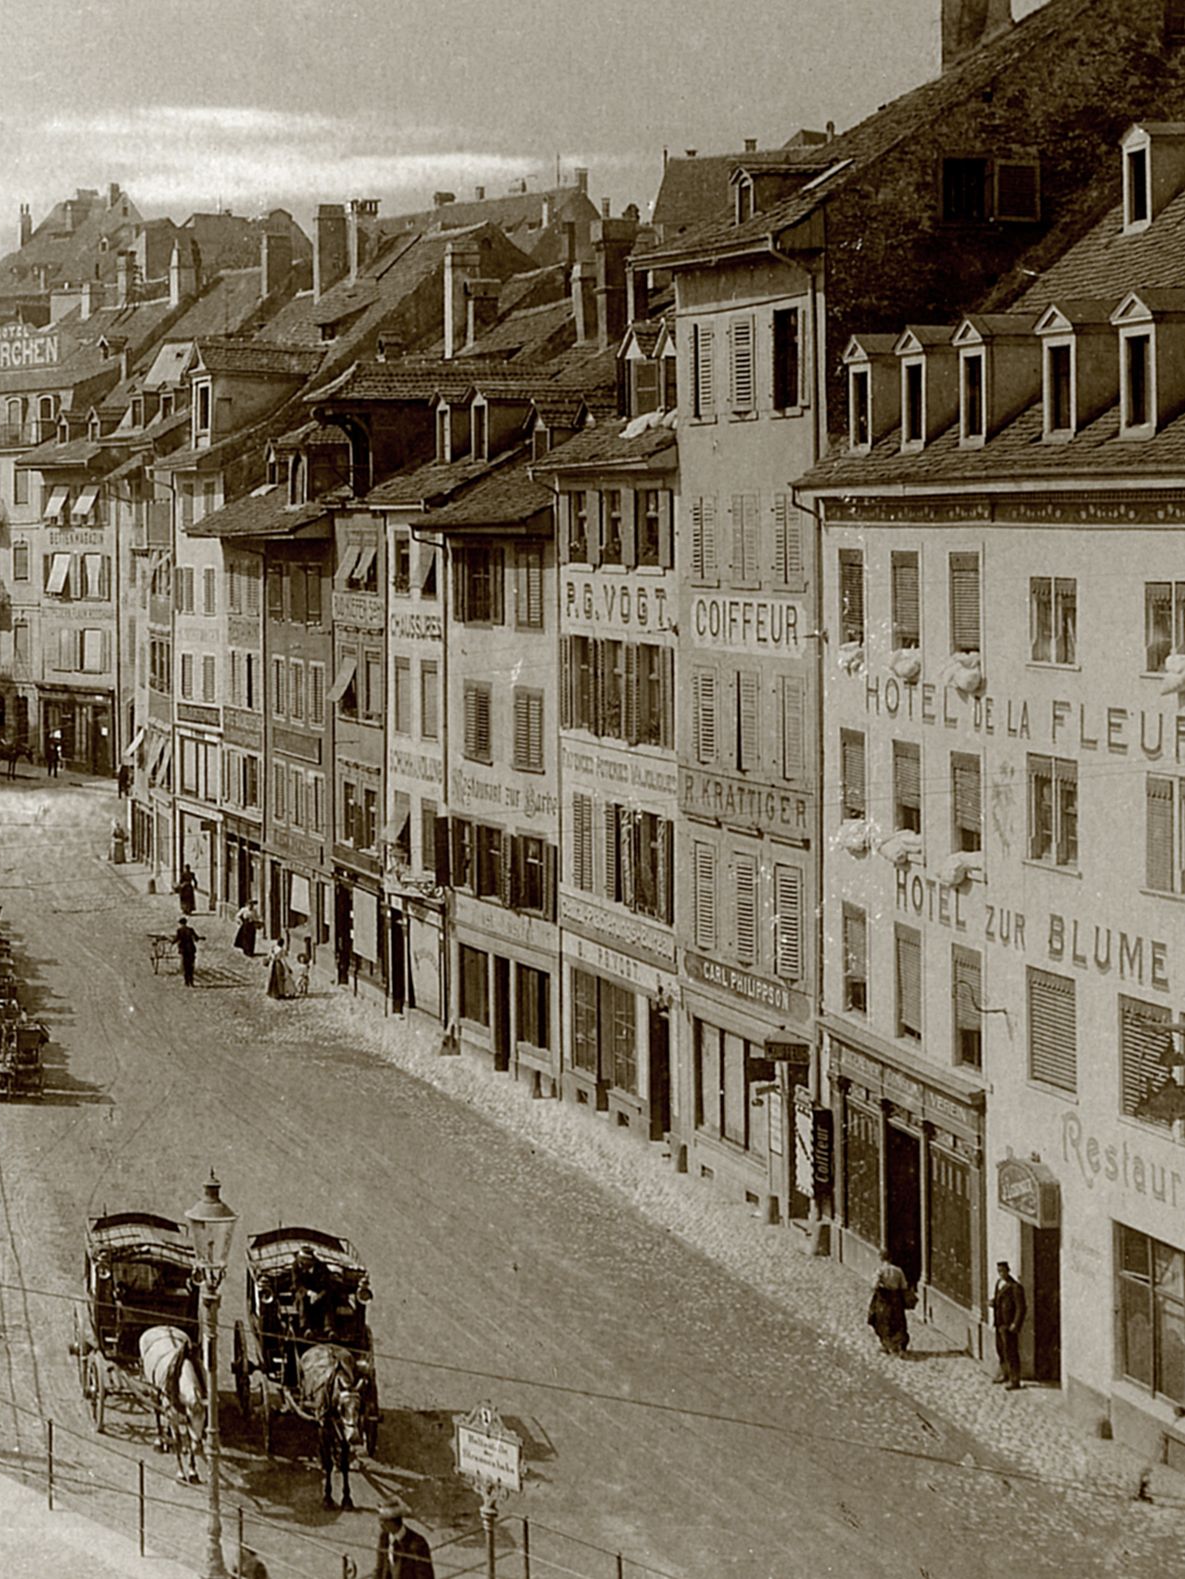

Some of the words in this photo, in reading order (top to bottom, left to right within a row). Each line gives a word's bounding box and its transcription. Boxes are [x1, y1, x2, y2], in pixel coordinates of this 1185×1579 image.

[696, 599, 798, 646] COIFFEUR
[866, 674, 958, 728] HOTEL
[974, 695, 995, 735] DE
[1007, 699, 1030, 740] LA
[701, 779, 806, 829] KRATTIGER
[896, 868, 966, 932] HOTEL
[985, 904, 1026, 951] ZUR
[1049, 912, 1170, 992] BLUME
[703, 960, 728, 990] CARL
[730, 971, 790, 1011] PHILIPPSON
